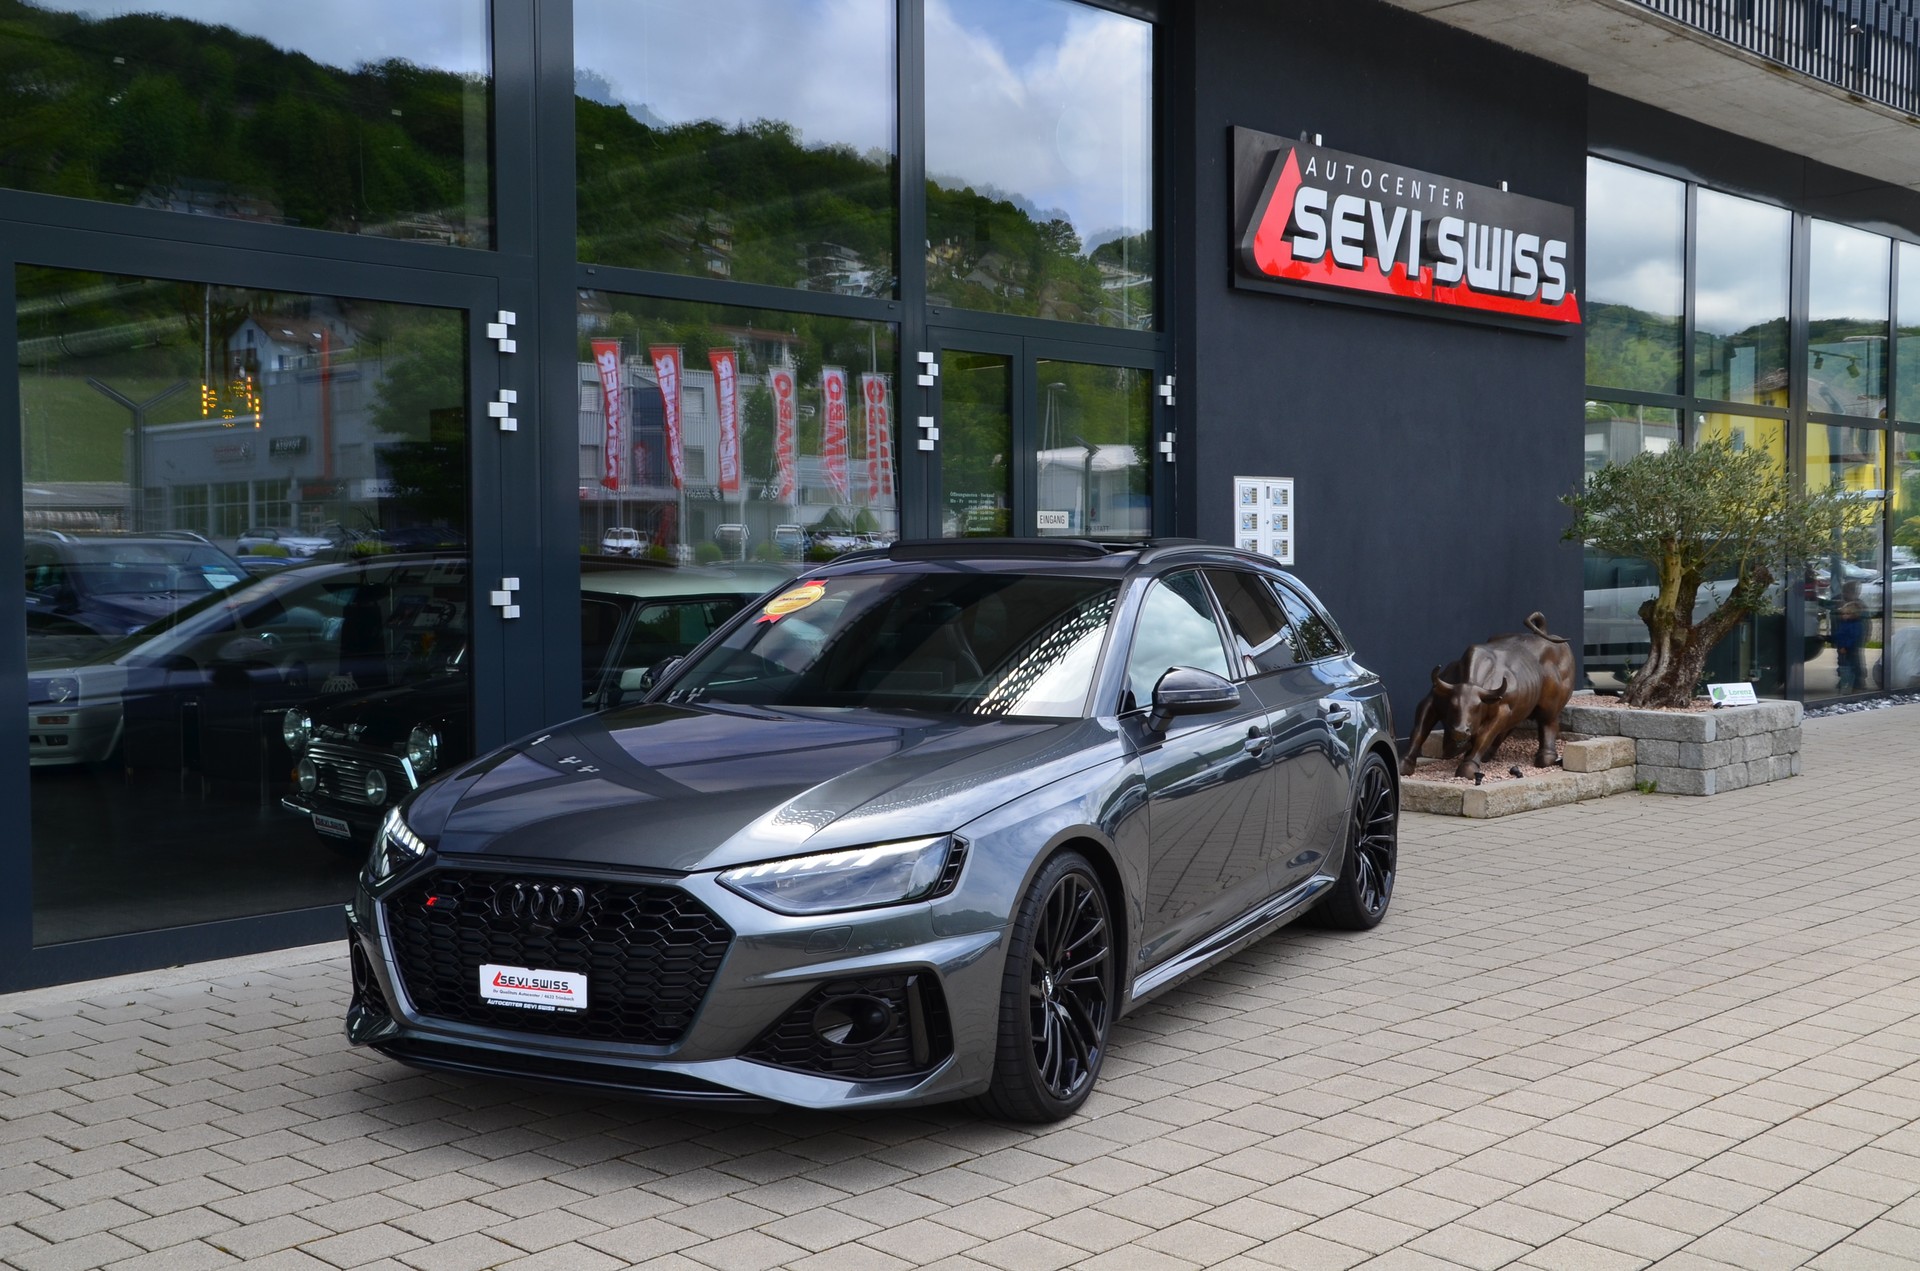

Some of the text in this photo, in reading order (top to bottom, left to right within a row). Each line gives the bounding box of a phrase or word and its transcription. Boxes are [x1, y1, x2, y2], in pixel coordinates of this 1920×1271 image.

[1305, 156, 1465, 210] AUTOCENTER
[1292, 186, 1567, 302] SEVI SWISS
[1039, 514, 1065, 525] EINGANG
[500, 975, 569, 991] SEVI SWISS
